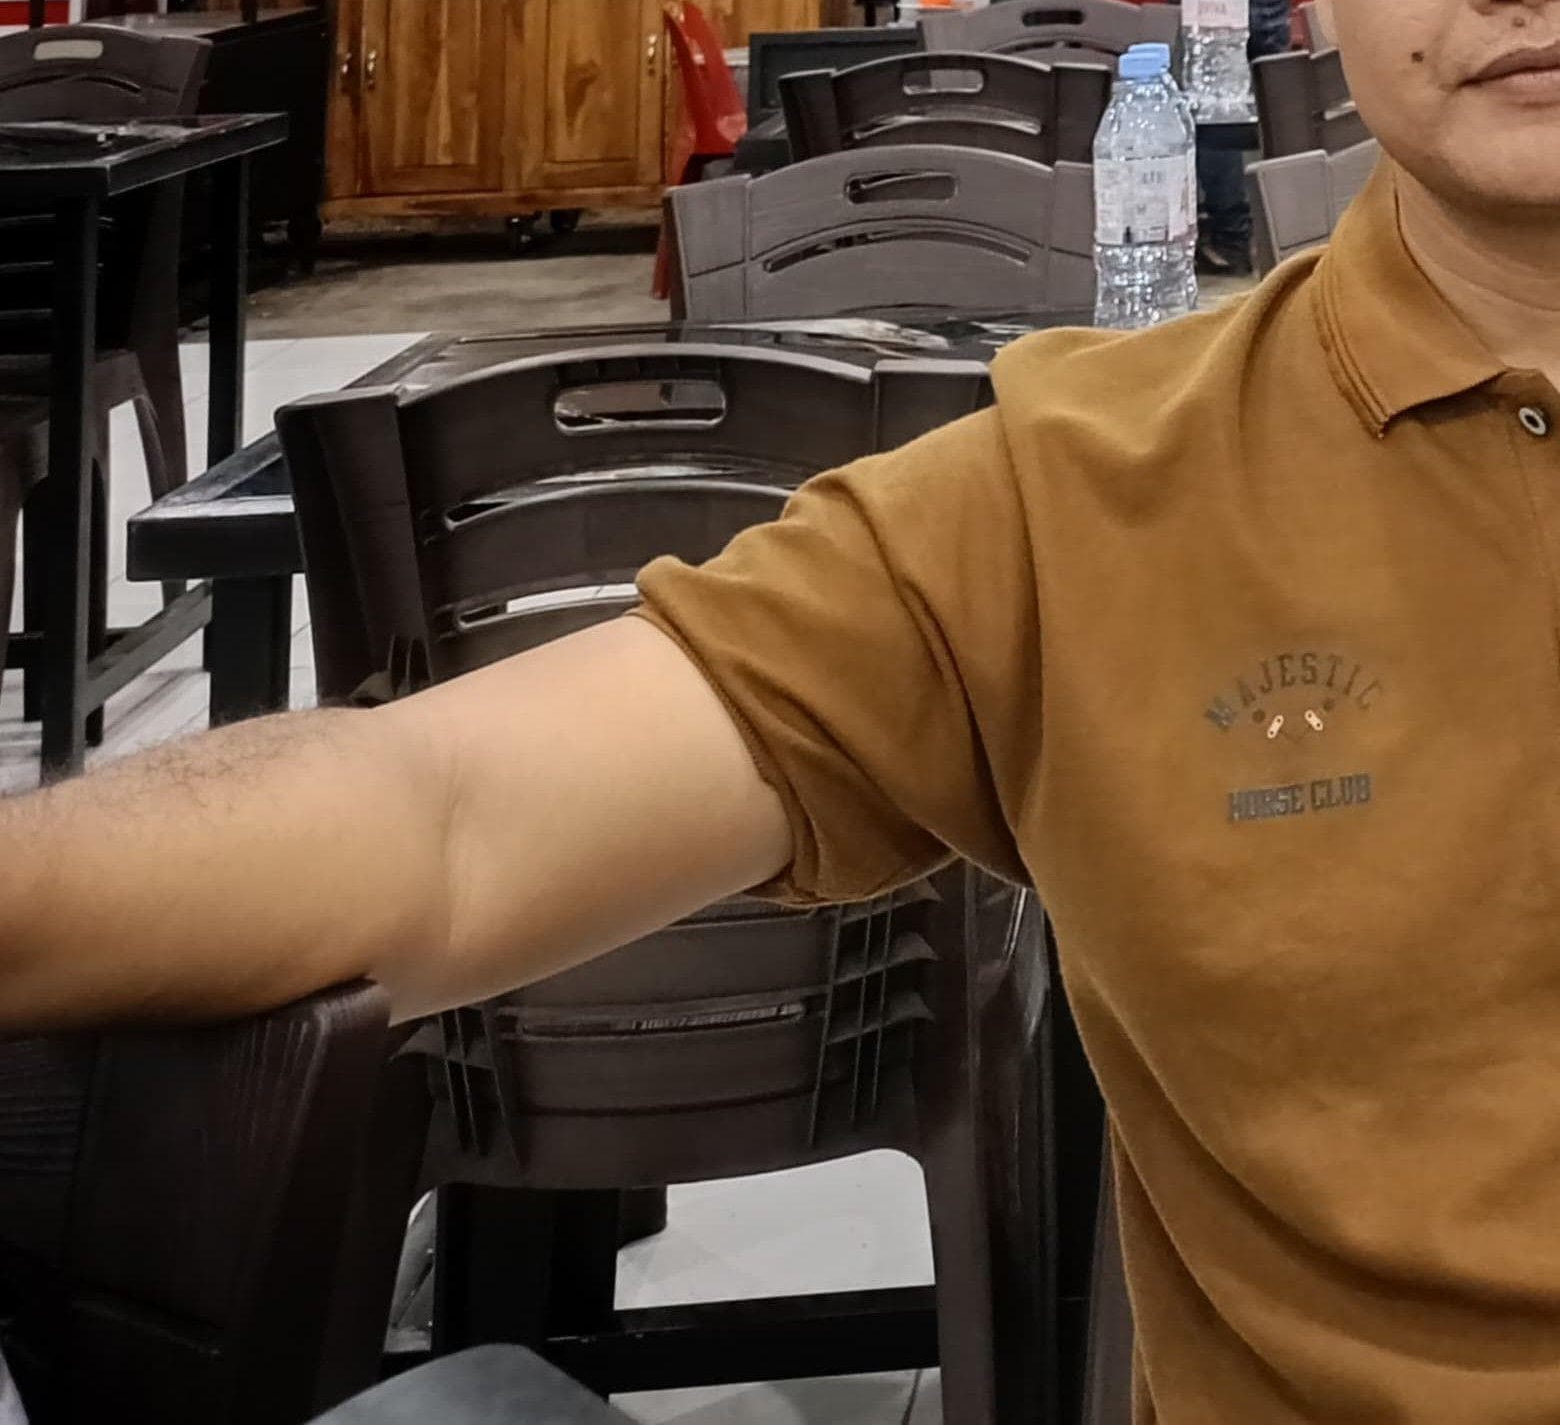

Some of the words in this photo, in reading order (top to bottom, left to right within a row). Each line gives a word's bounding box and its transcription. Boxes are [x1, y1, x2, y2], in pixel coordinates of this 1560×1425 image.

[1205, 652, 1384, 734] MAJESTIC
[1228, 784, 1305, 821] HORSE
[1310, 773, 1371, 811] CLUB
